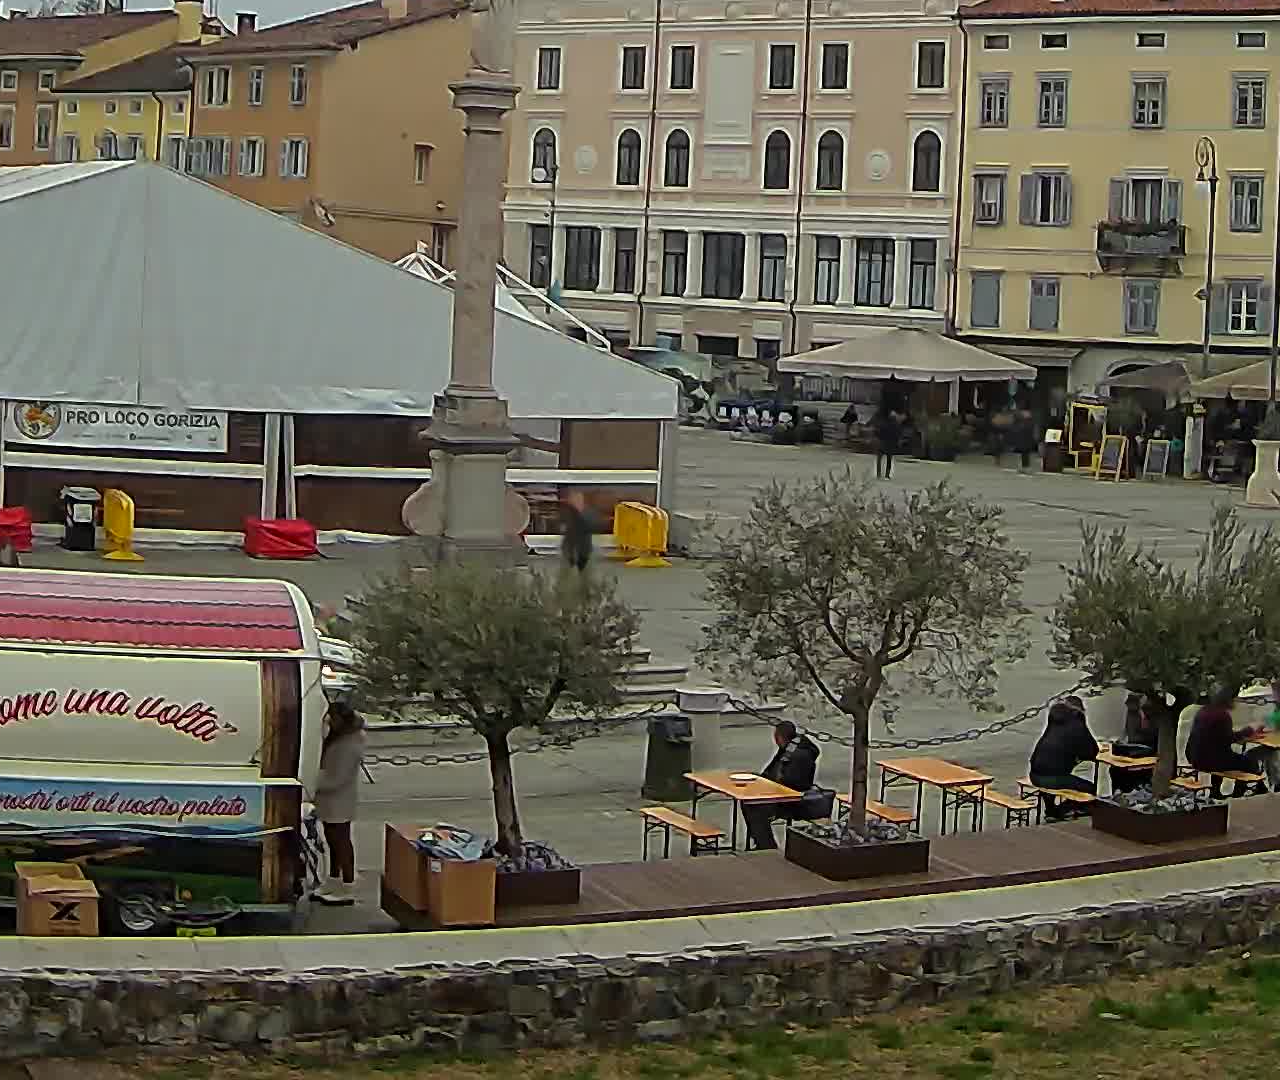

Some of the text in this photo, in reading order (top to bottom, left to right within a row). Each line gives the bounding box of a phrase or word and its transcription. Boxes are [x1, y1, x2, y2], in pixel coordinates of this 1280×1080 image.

[66, 410, 220, 428] PRO LOCO GORIZIA
[63, 688, 131, 716] una
[55, 791, 96, 812] orti
[92, 792, 119, 812] al
[118, 794, 179, 815] vostro
[177, 794, 246, 822] palato
